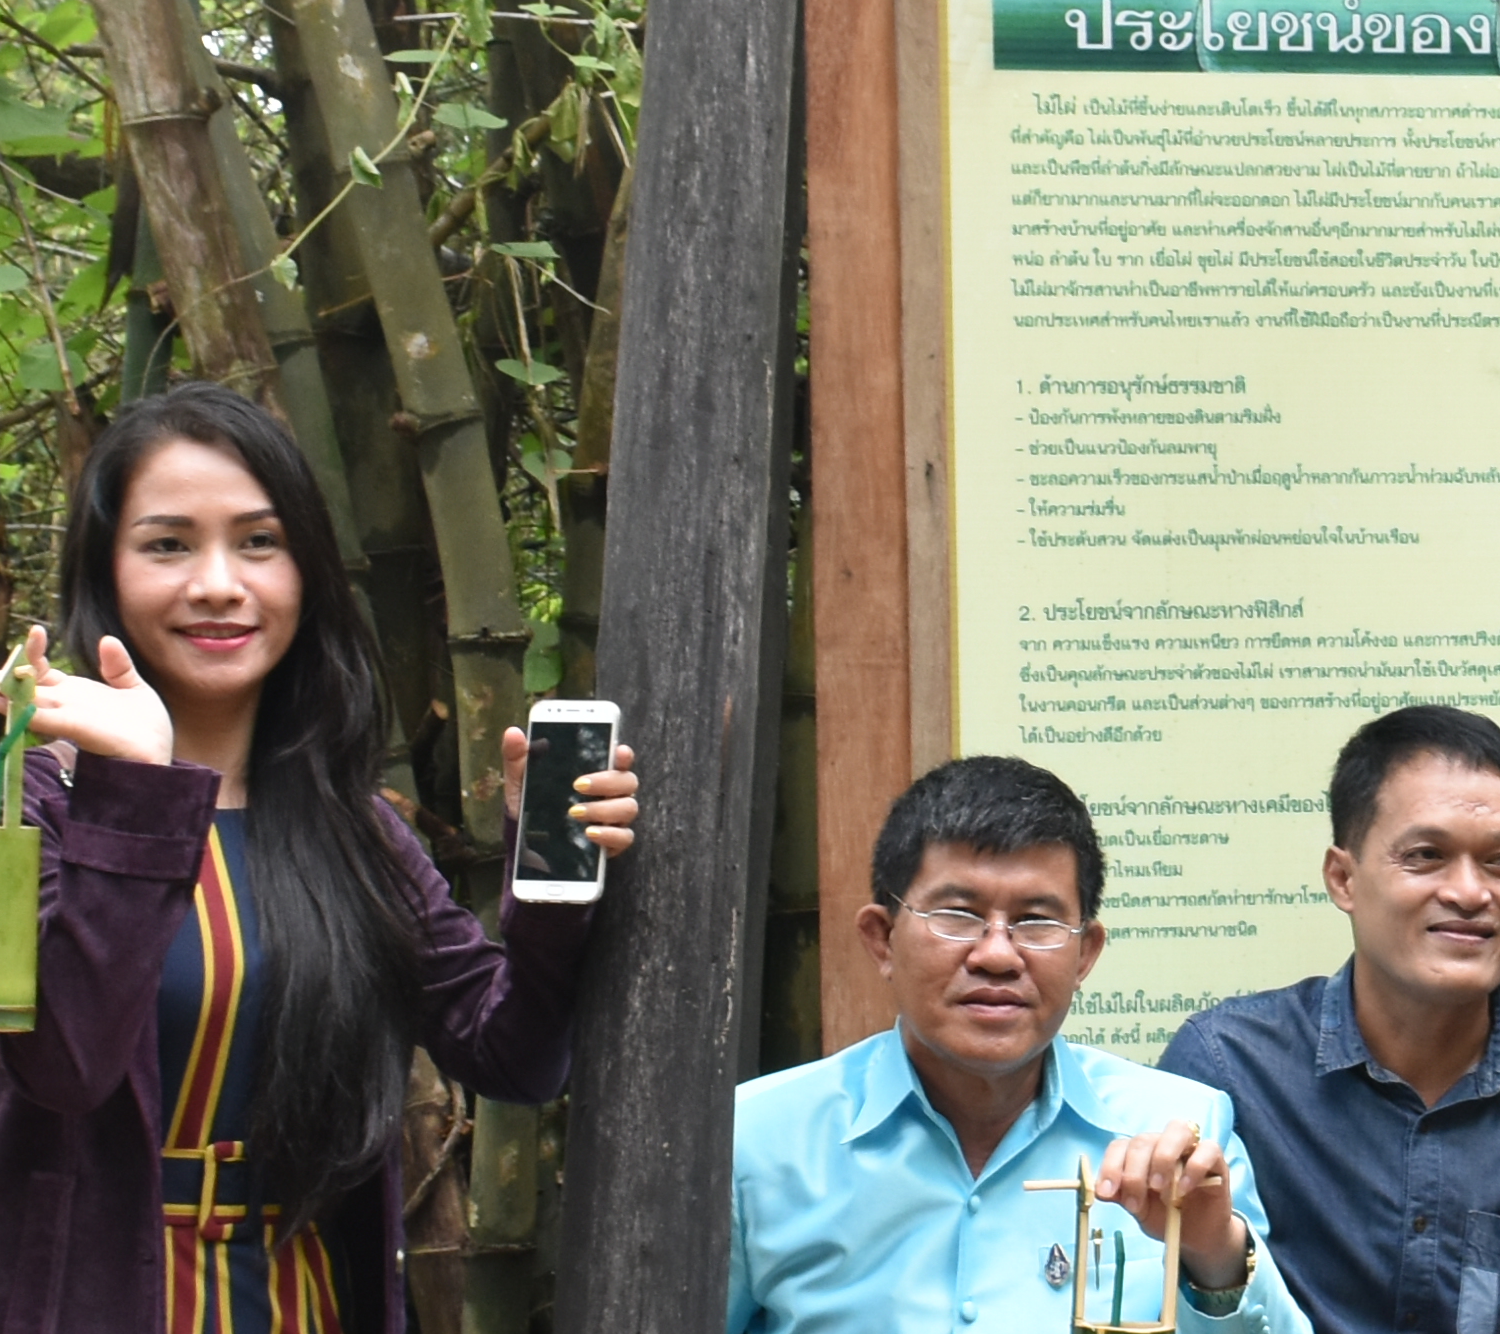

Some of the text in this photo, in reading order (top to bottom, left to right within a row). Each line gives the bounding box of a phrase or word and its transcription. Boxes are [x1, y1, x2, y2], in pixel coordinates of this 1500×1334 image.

[1032, 91, 1078, 117] ไม้ไผ่
[1010, 124, 1085, 151] ที่สำคัญคือ
[1012, 250, 1045, 267] หน่อ
[1049, 249, 1089, 267] ลำต้น
[1093, 246, 1112, 267] ใบ
[1116, 254, 1144, 267] ราก
[1149, 246, 1193, 267] เยื่อไผ่
[1197, 248, 1234, 274] ขุยไผ่
[1016, 378, 1032, 395] 1.
[1028, 495, 1126, 517] ให้ความร่มรื่น
[1028, 525, 1127, 548] ใช้ประดับสวน
[1018, 605, 1036, 622] 2.
[1019, 639, 1047, 652] จาก
[1052, 632, 1150, 651] ความแข็งแรง
[1154, 632, 1240, 650] ความเหนียว
[1244, 631, 1312, 649] การยืดหด
[1316, 627, 1398, 648] ความโค้งงอ
[1018, 693, 1127, 713] ในงานคอนกรีต
[1110, 1022, 1141, 1044] ดังนี้
